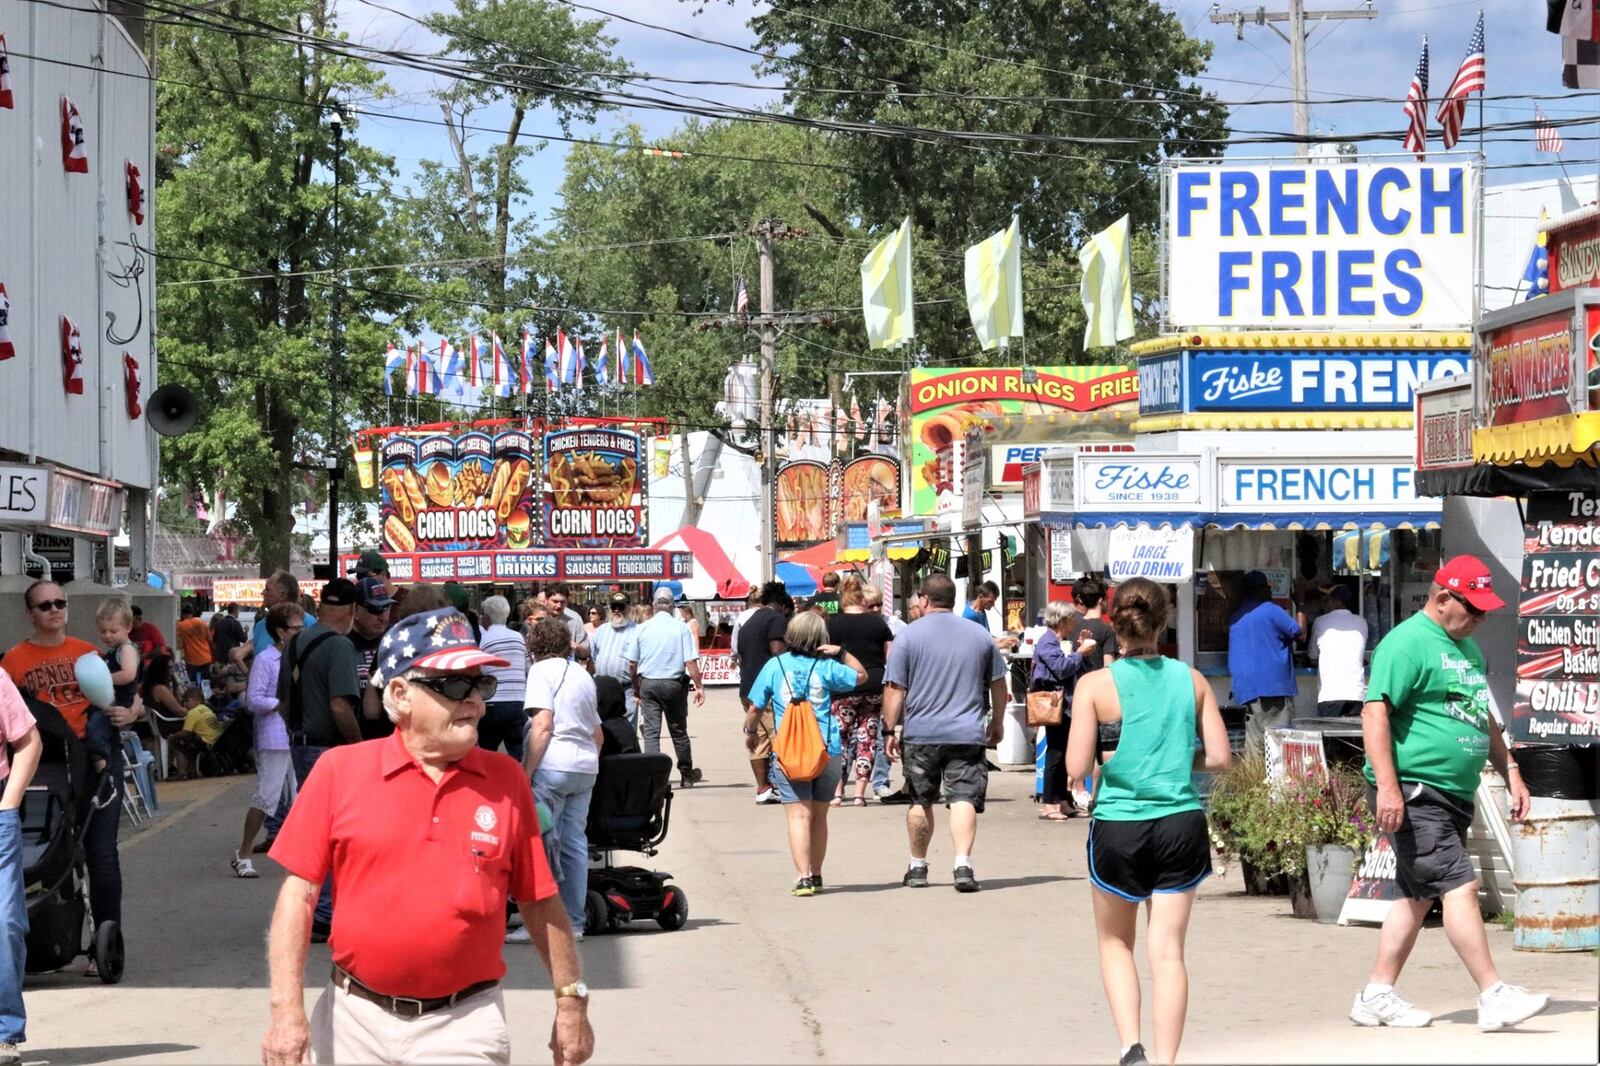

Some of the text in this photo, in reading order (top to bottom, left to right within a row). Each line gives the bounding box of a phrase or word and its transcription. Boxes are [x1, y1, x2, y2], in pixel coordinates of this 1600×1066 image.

[1177, 166, 1465, 237] FRENCH
[1218, 248, 1424, 317] FRIES
[918, 375, 1139, 404] ONION RINGS FRIED
[1201, 361, 1283, 401] Fiske
[386, 442, 416, 459] SAUSAGE
[551, 434, 635, 452] CHICKEN TENDERS & FRIES
[1006, 447, 1050, 462] PEP
[1095, 464, 1190, 490] Fiske
[1236, 467, 1375, 501] FRENCH
[830, 472, 839, 538] FRIES
[1109, 492, 1179, 501] SINCE 1938
[417, 509, 497, 539] CORN DOGS
[551, 509, 635, 534] CORN DOGS
[503, 554, 545, 562] ICE COLD
[1132, 545, 1169, 559] LARGE
[421, 564, 454, 578] SAUSAGE
[496, 562, 556, 575] DRINKS
[566, 562, 611, 575] SAUSAGE
[618, 562, 663, 574] TENDERLOINS
[1112, 560, 1185, 577] COLD DRINK
[1530, 560, 1581, 588] Fried
[1556, 594, 1574, 612] On
[1578, 599, 1586, 610] a
[1527, 619, 1571, 645] Chicken
[701, 671, 730, 680] EESE
[1531, 681, 1582, 713] Chili
[1529, 718, 1568, 737] Regular
[1570, 720, 1588, 735] and
